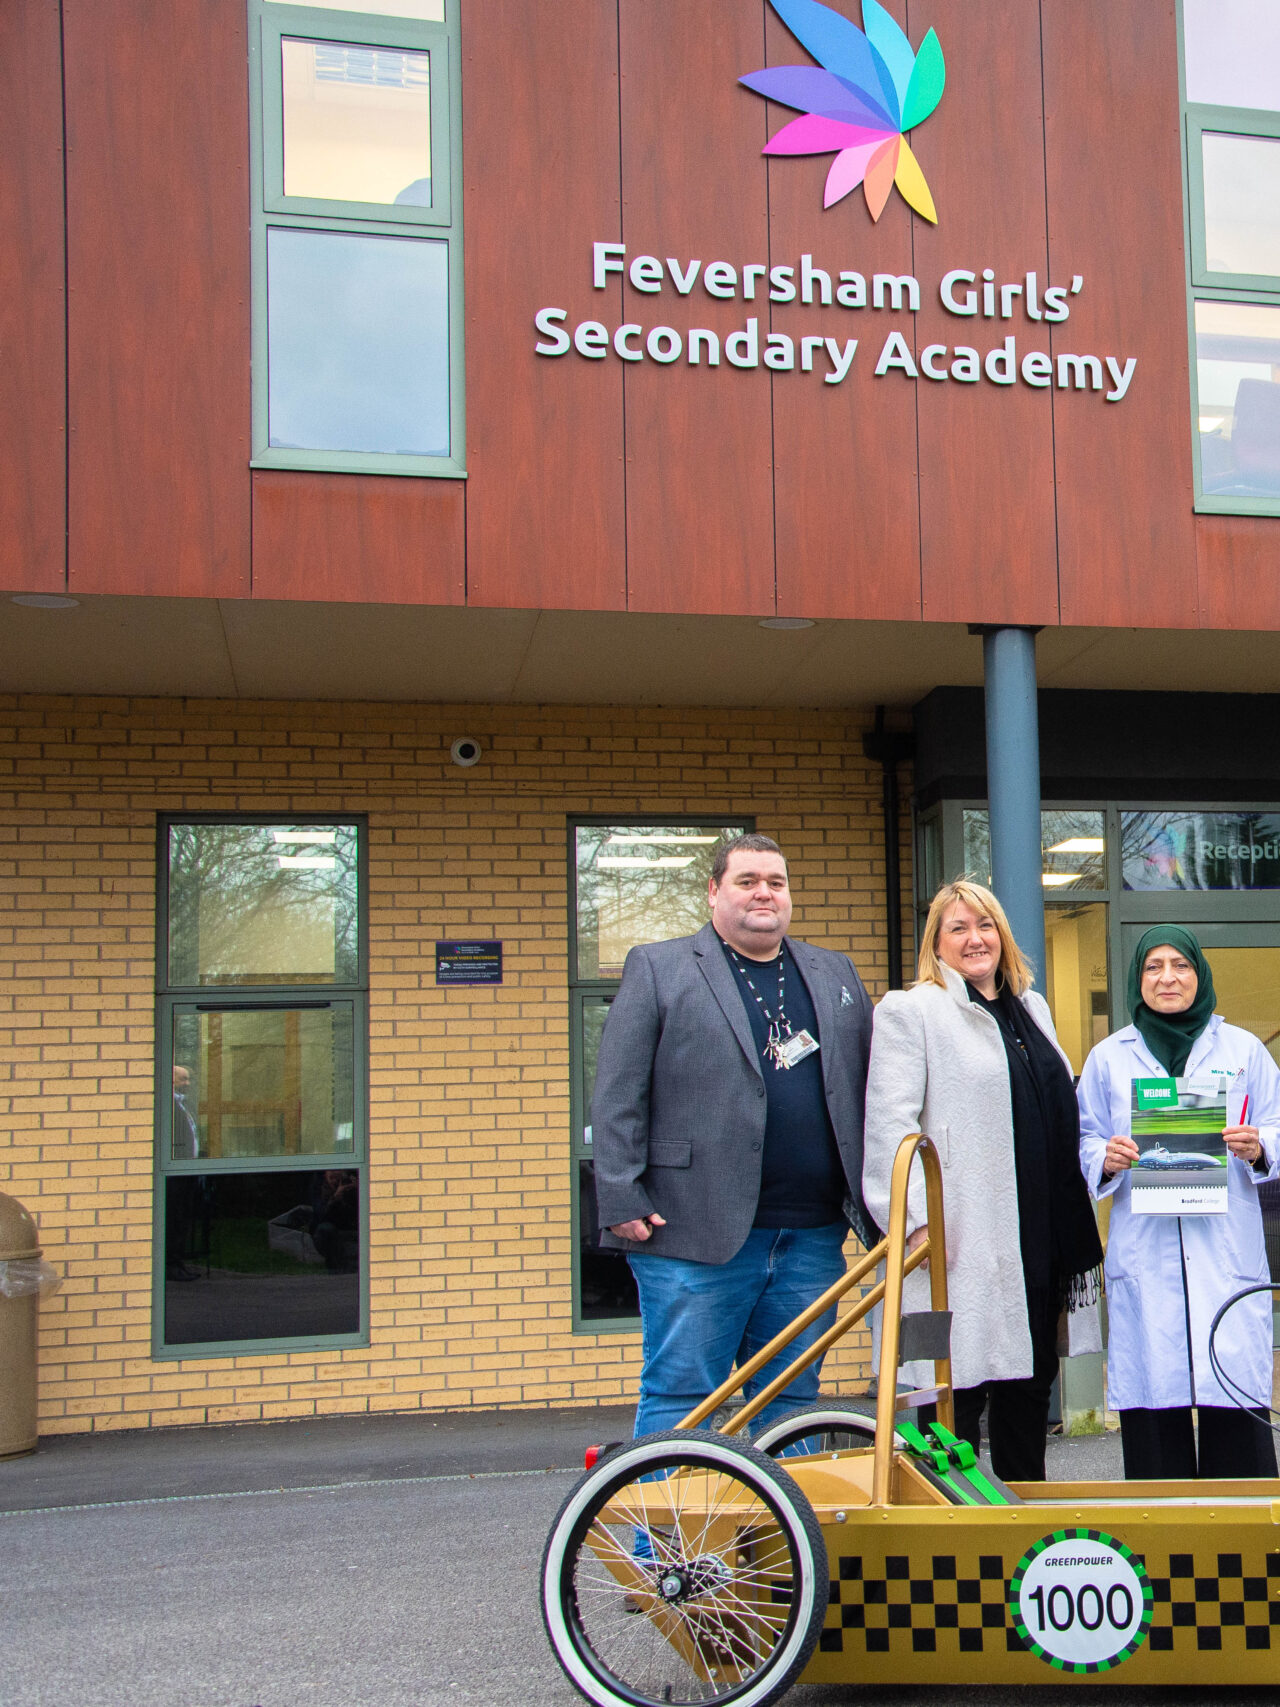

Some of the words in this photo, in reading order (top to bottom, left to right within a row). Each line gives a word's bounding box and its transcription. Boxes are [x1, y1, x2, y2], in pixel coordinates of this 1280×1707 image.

[592, 242, 921, 312] Feversham
[533, 308, 859, 384] Secondary
[874, 331, 1138, 402] Academy
[1143, 1088, 1171, 1098] WELCOME
[1045, 1557, 1113, 1566] GREENPOWER
[1028, 1583, 1133, 1632] 1000
